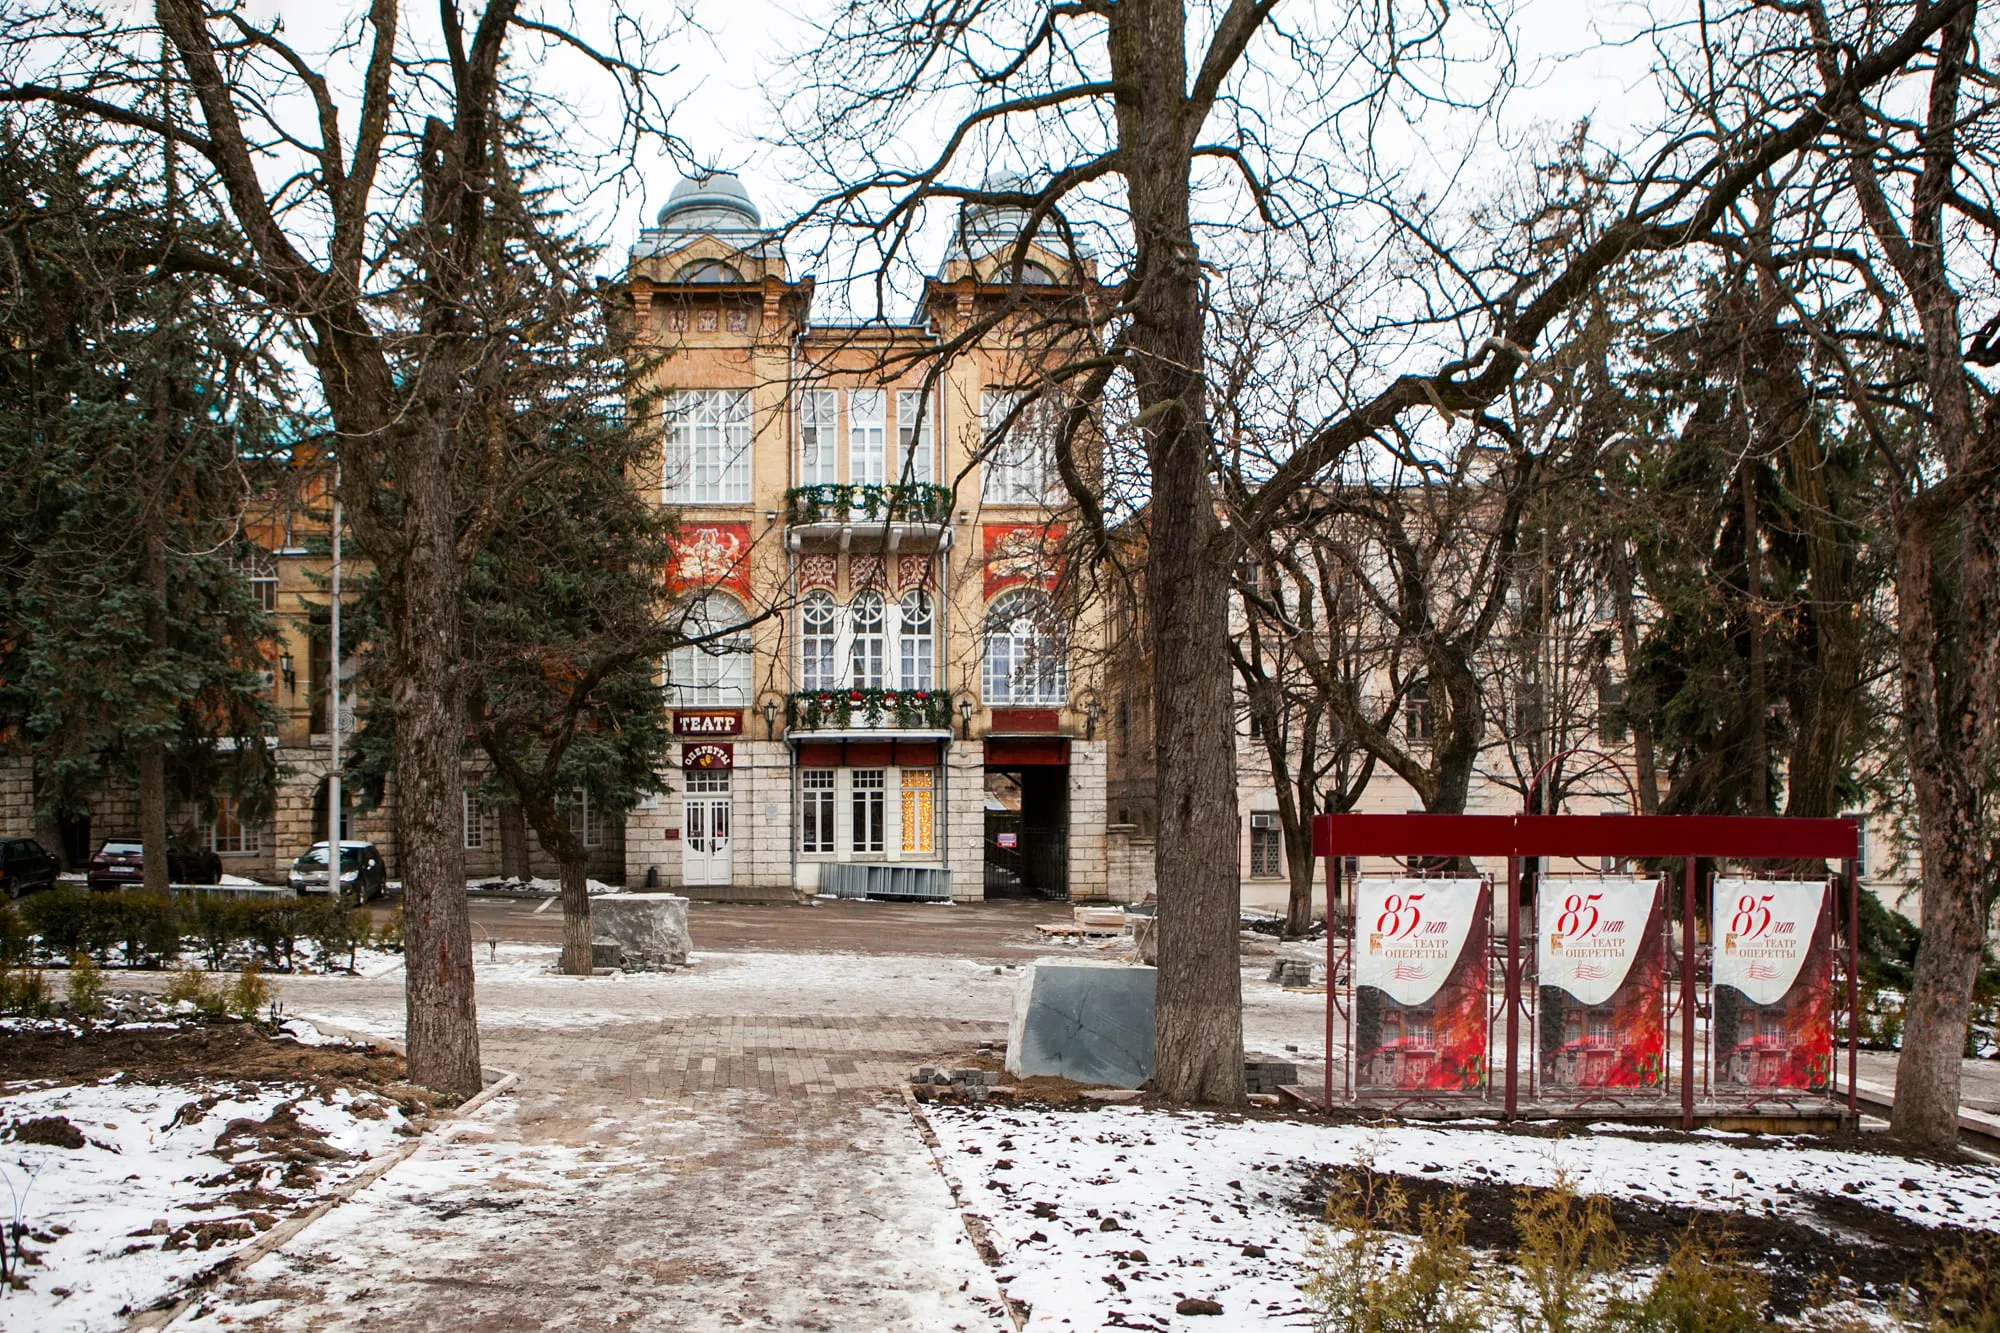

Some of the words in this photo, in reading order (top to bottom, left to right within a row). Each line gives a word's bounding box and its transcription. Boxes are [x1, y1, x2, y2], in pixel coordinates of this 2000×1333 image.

[680, 716, 736, 732] ТЕАТР
[684, 745, 731, 766] ОПЕРЕТТЫ
[1377, 893, 1425, 941] 85
[1413, 921, 1448, 938] лет
[1557, 893, 1603, 941] 85
[1592, 920, 1624, 938] лет
[1731, 894, 1775, 941] 85
[1764, 921, 1795, 938] лет
[1413, 939, 1448, 949] ТЕАТР
[1592, 938, 1625, 948] ТЕАТР
[1764, 939, 1797, 949] ТЕАТР
[1385, 949, 1448, 959] ОПЕРЕТТЫ
[1565, 948, 1625, 958] ОПЕРЕТТЫ
[1739, 949, 1796, 959] ОПЕРЕТТЫ
